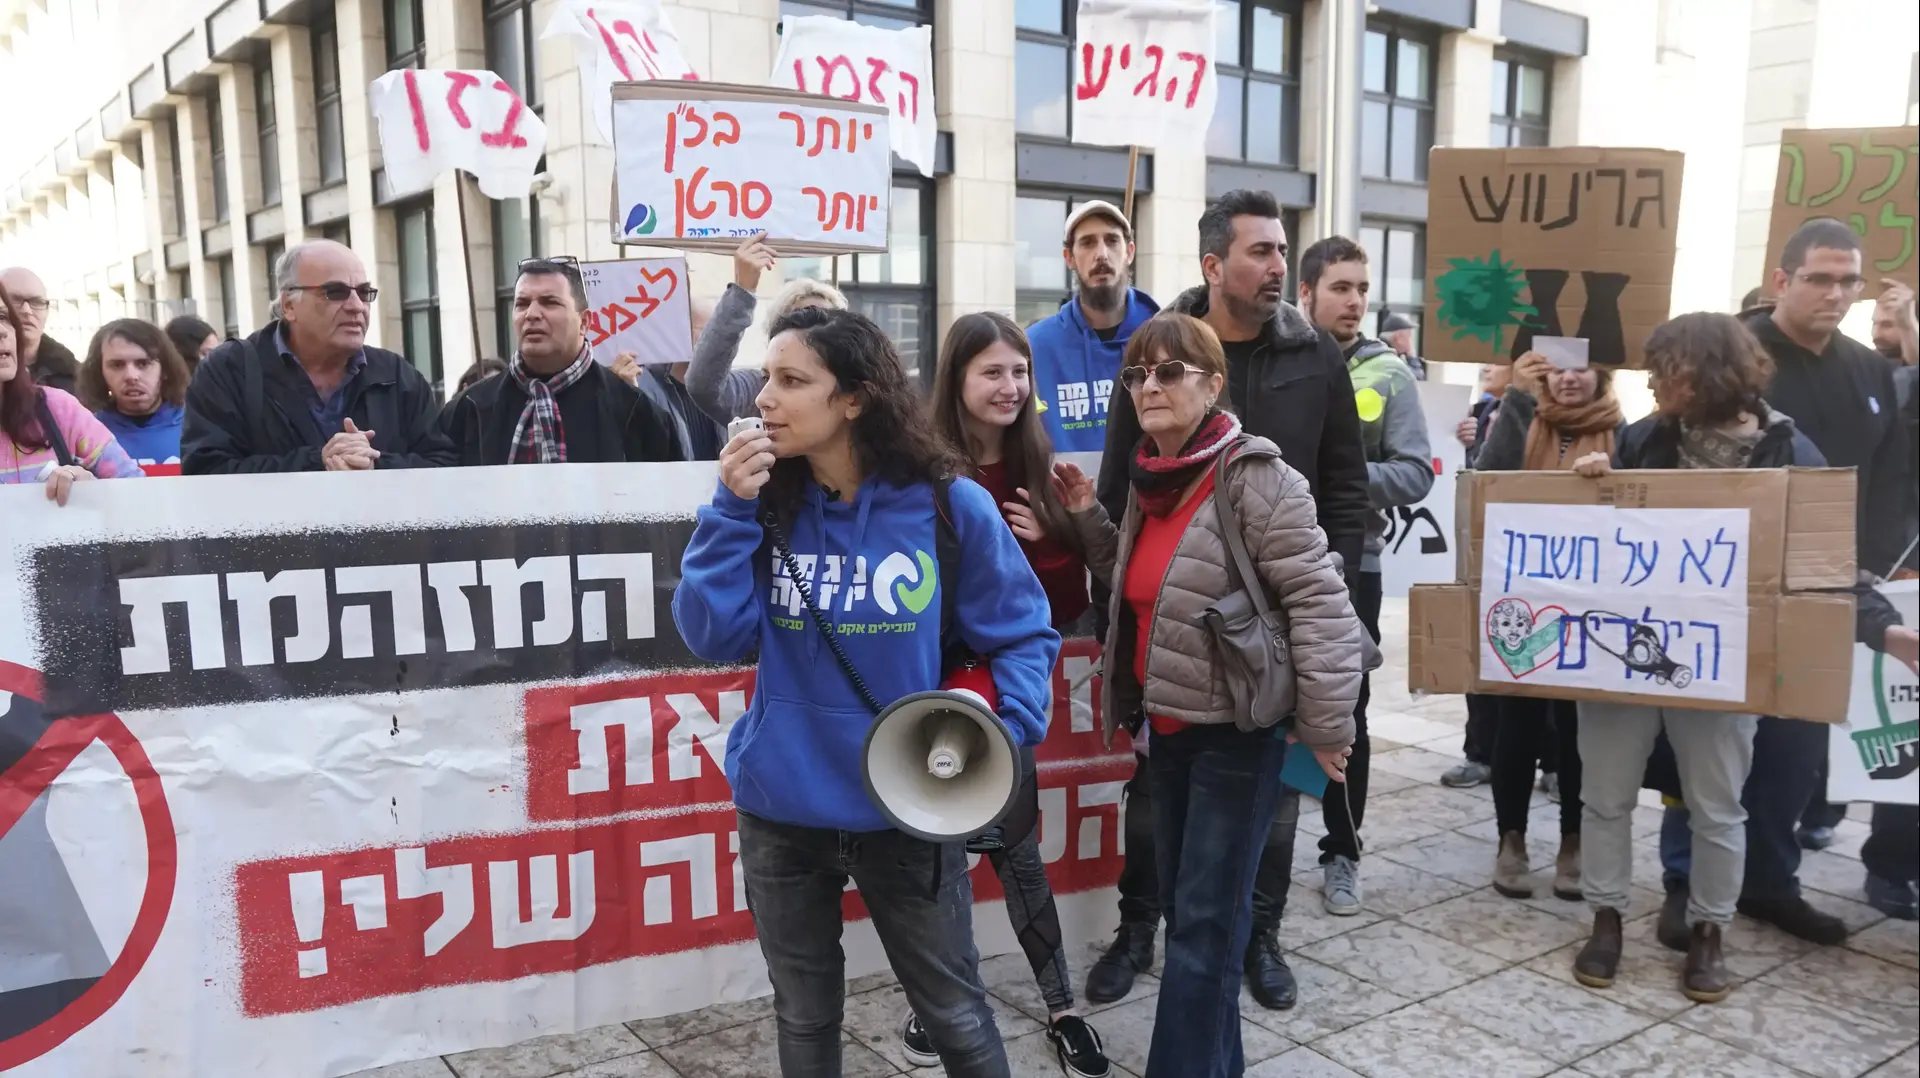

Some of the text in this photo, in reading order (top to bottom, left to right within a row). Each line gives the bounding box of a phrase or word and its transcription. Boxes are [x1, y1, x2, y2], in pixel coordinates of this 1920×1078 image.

[1076, 41, 1206, 109] הגיע
[402, 68, 528, 154] בזן
[778, 110, 874, 158] יותר
[674, 166, 878, 238] יותר סרטן
[1459, 168, 1667, 230] גרינווש
[1502, 528, 1600, 592] חשבון
[1615, 527, 1659, 587] על
[1678, 527, 1737, 588] לא
[119, 551, 656, 675] המזהמת
[568, 690, 746, 795] את
[288, 847, 597, 978] שלי!
